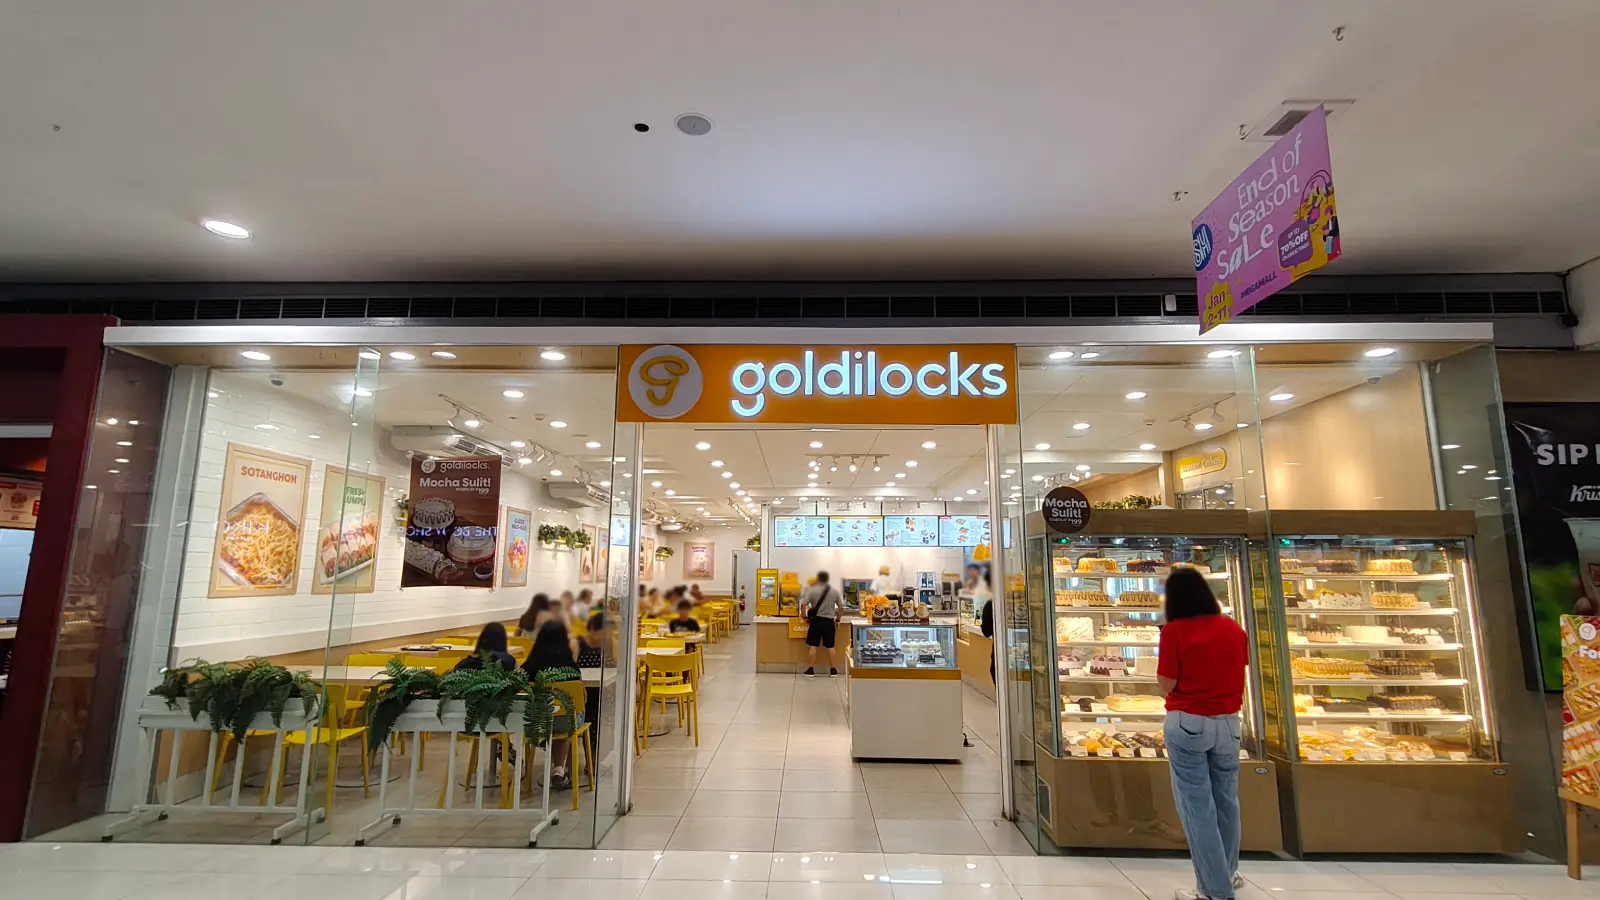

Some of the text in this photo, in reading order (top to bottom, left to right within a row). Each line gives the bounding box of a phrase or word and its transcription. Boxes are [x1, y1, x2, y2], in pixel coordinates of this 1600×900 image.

[1237, 132, 1302, 209] End of
[1241, 271, 1278, 299] MEGAMALL
[1208, 291, 1226, 310] Jan
[1207, 305, 1228, 328] 2-11
[731, 351, 1008, 417] goldilocks
[1536, 443, 1589, 466] SIP
[240, 465, 297, 485] SOTANGHON
[440, 460, 488, 473] goldilocks
[420, 477, 491, 488] Mocha Sulit!
[1045, 497, 1088, 508] Mocha
[1051, 508, 1082, 518] Sulit!
